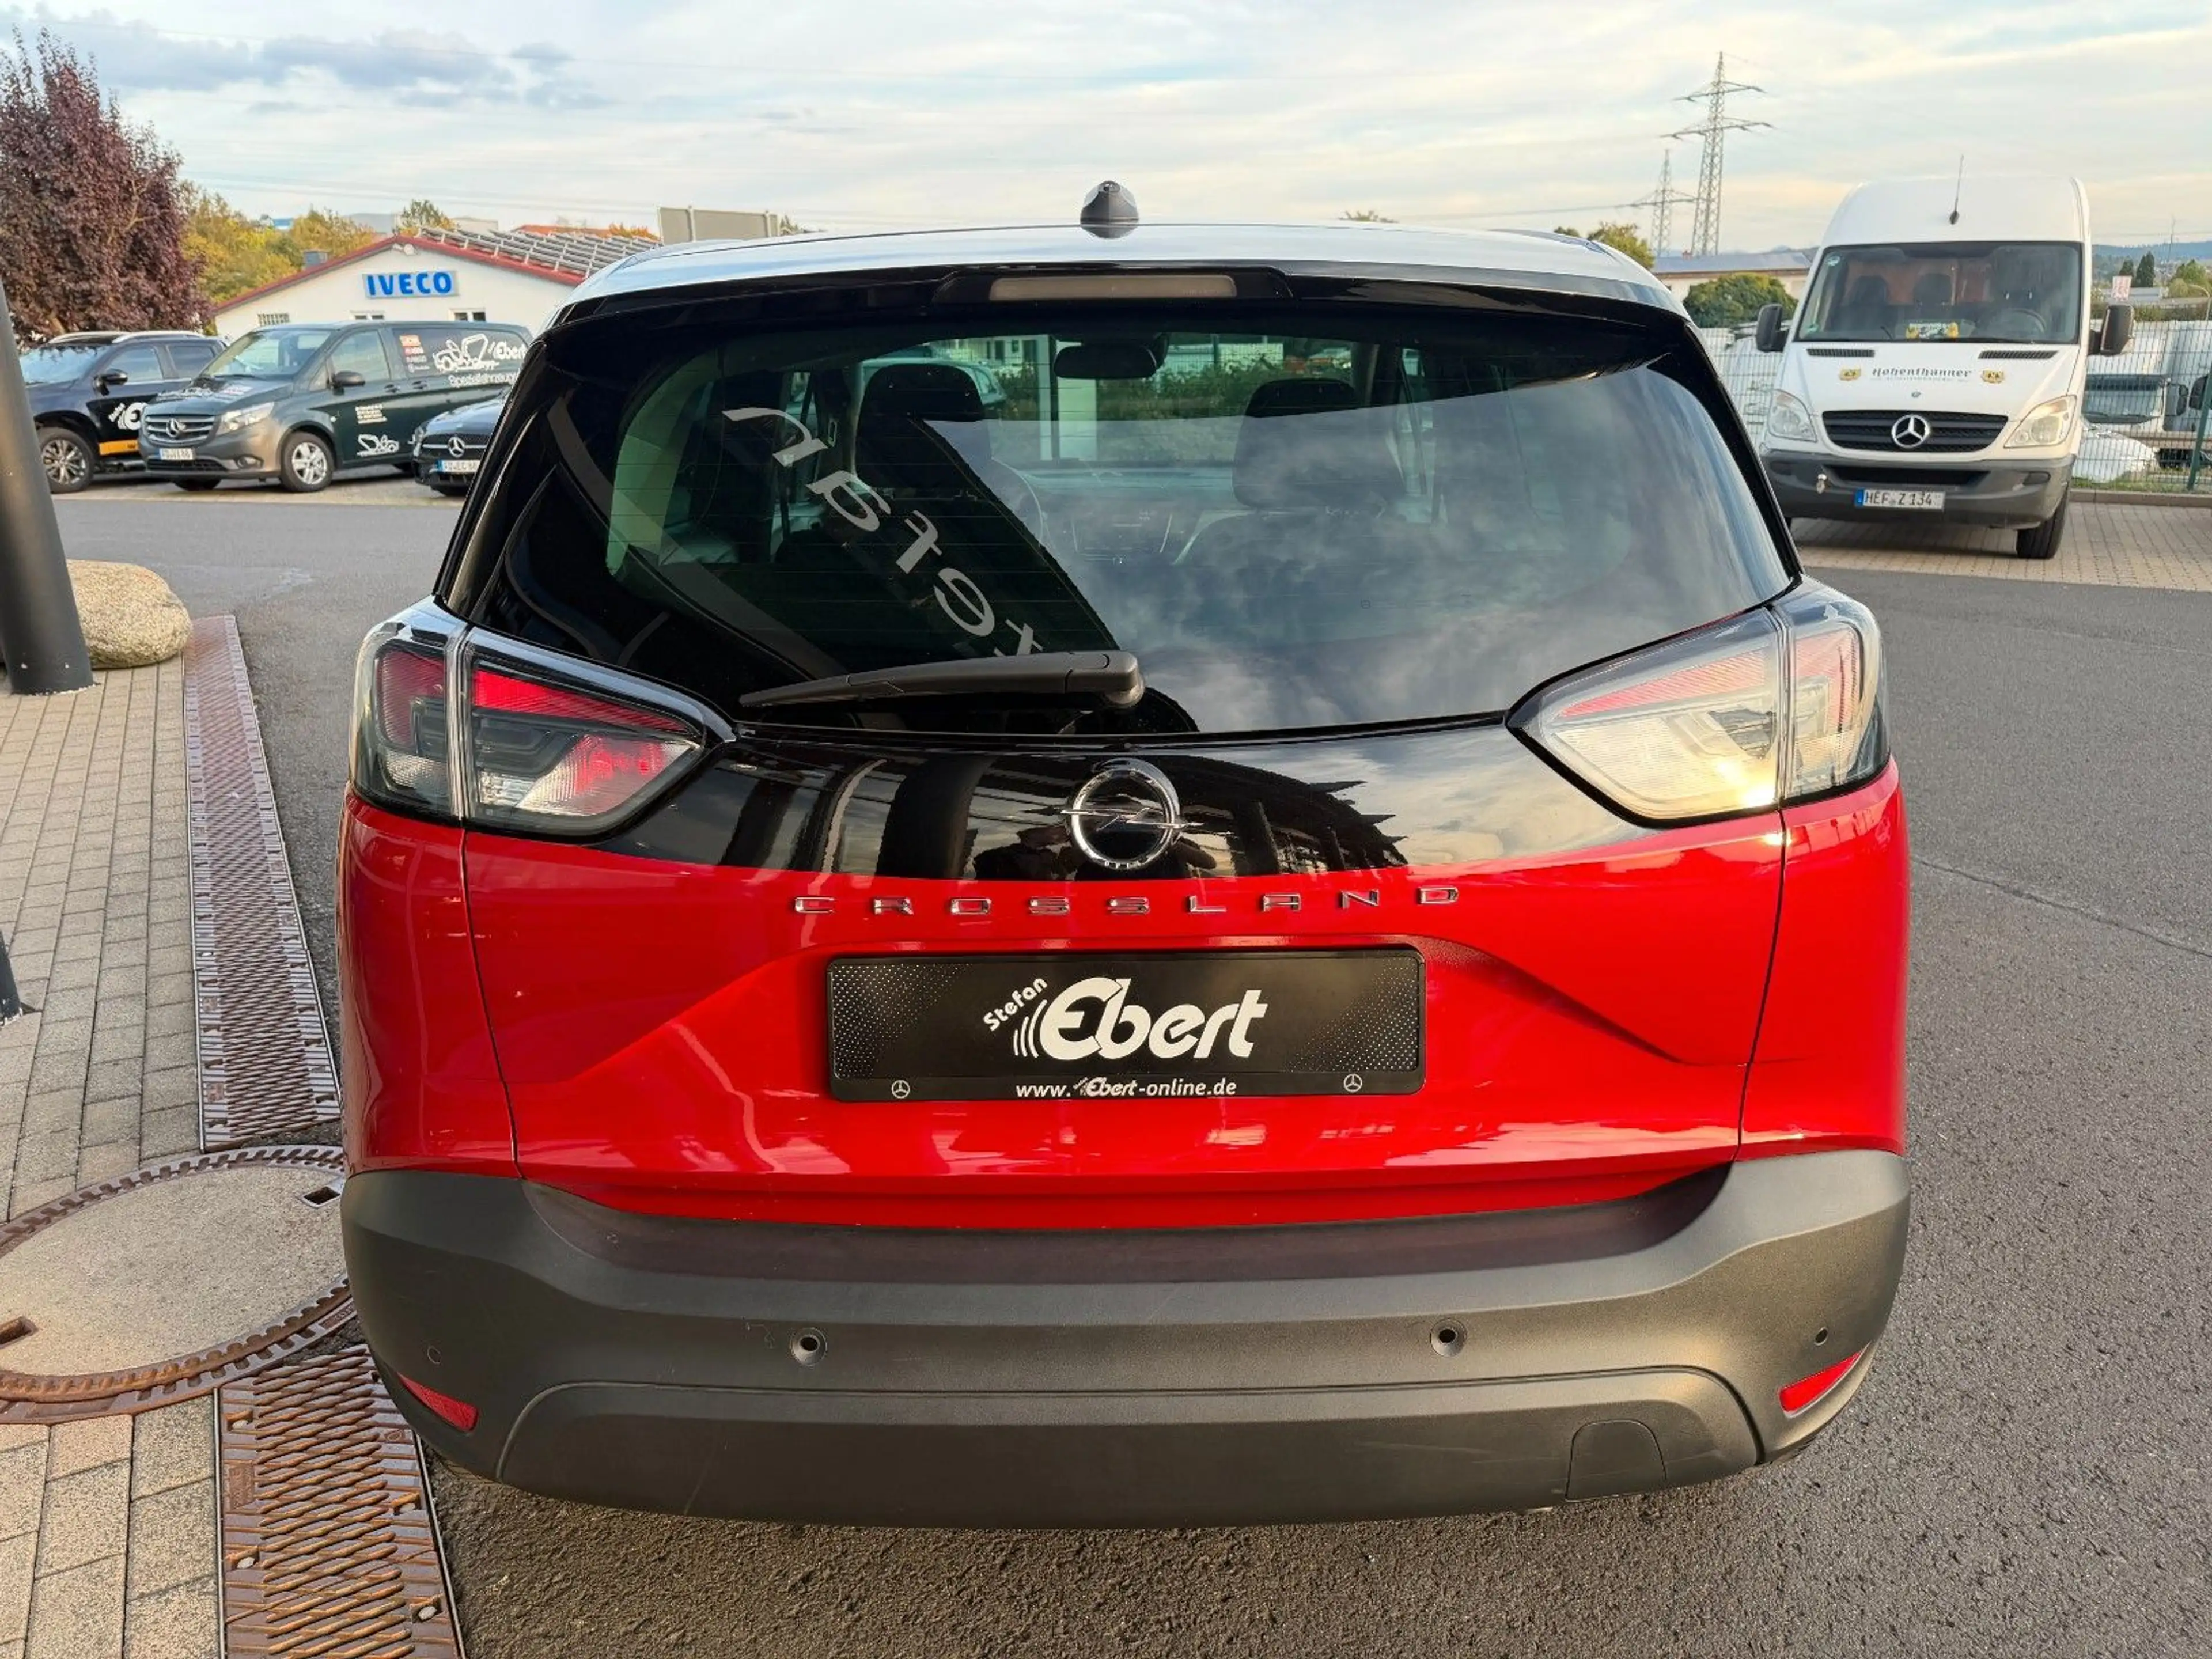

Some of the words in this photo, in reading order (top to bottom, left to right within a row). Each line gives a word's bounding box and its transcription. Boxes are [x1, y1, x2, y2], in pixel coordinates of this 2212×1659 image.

[366, 272, 452, 296] IVECO
[1866, 491, 1889, 505] HEF
[1899, 494, 1906, 505] Z
[1910, 494, 1932, 505] 134
[795, 886, 1460, 915] CROSSLAND
[983, 978, 1047, 1031] Stefan
[1039, 977, 1268, 1060] Ebert
